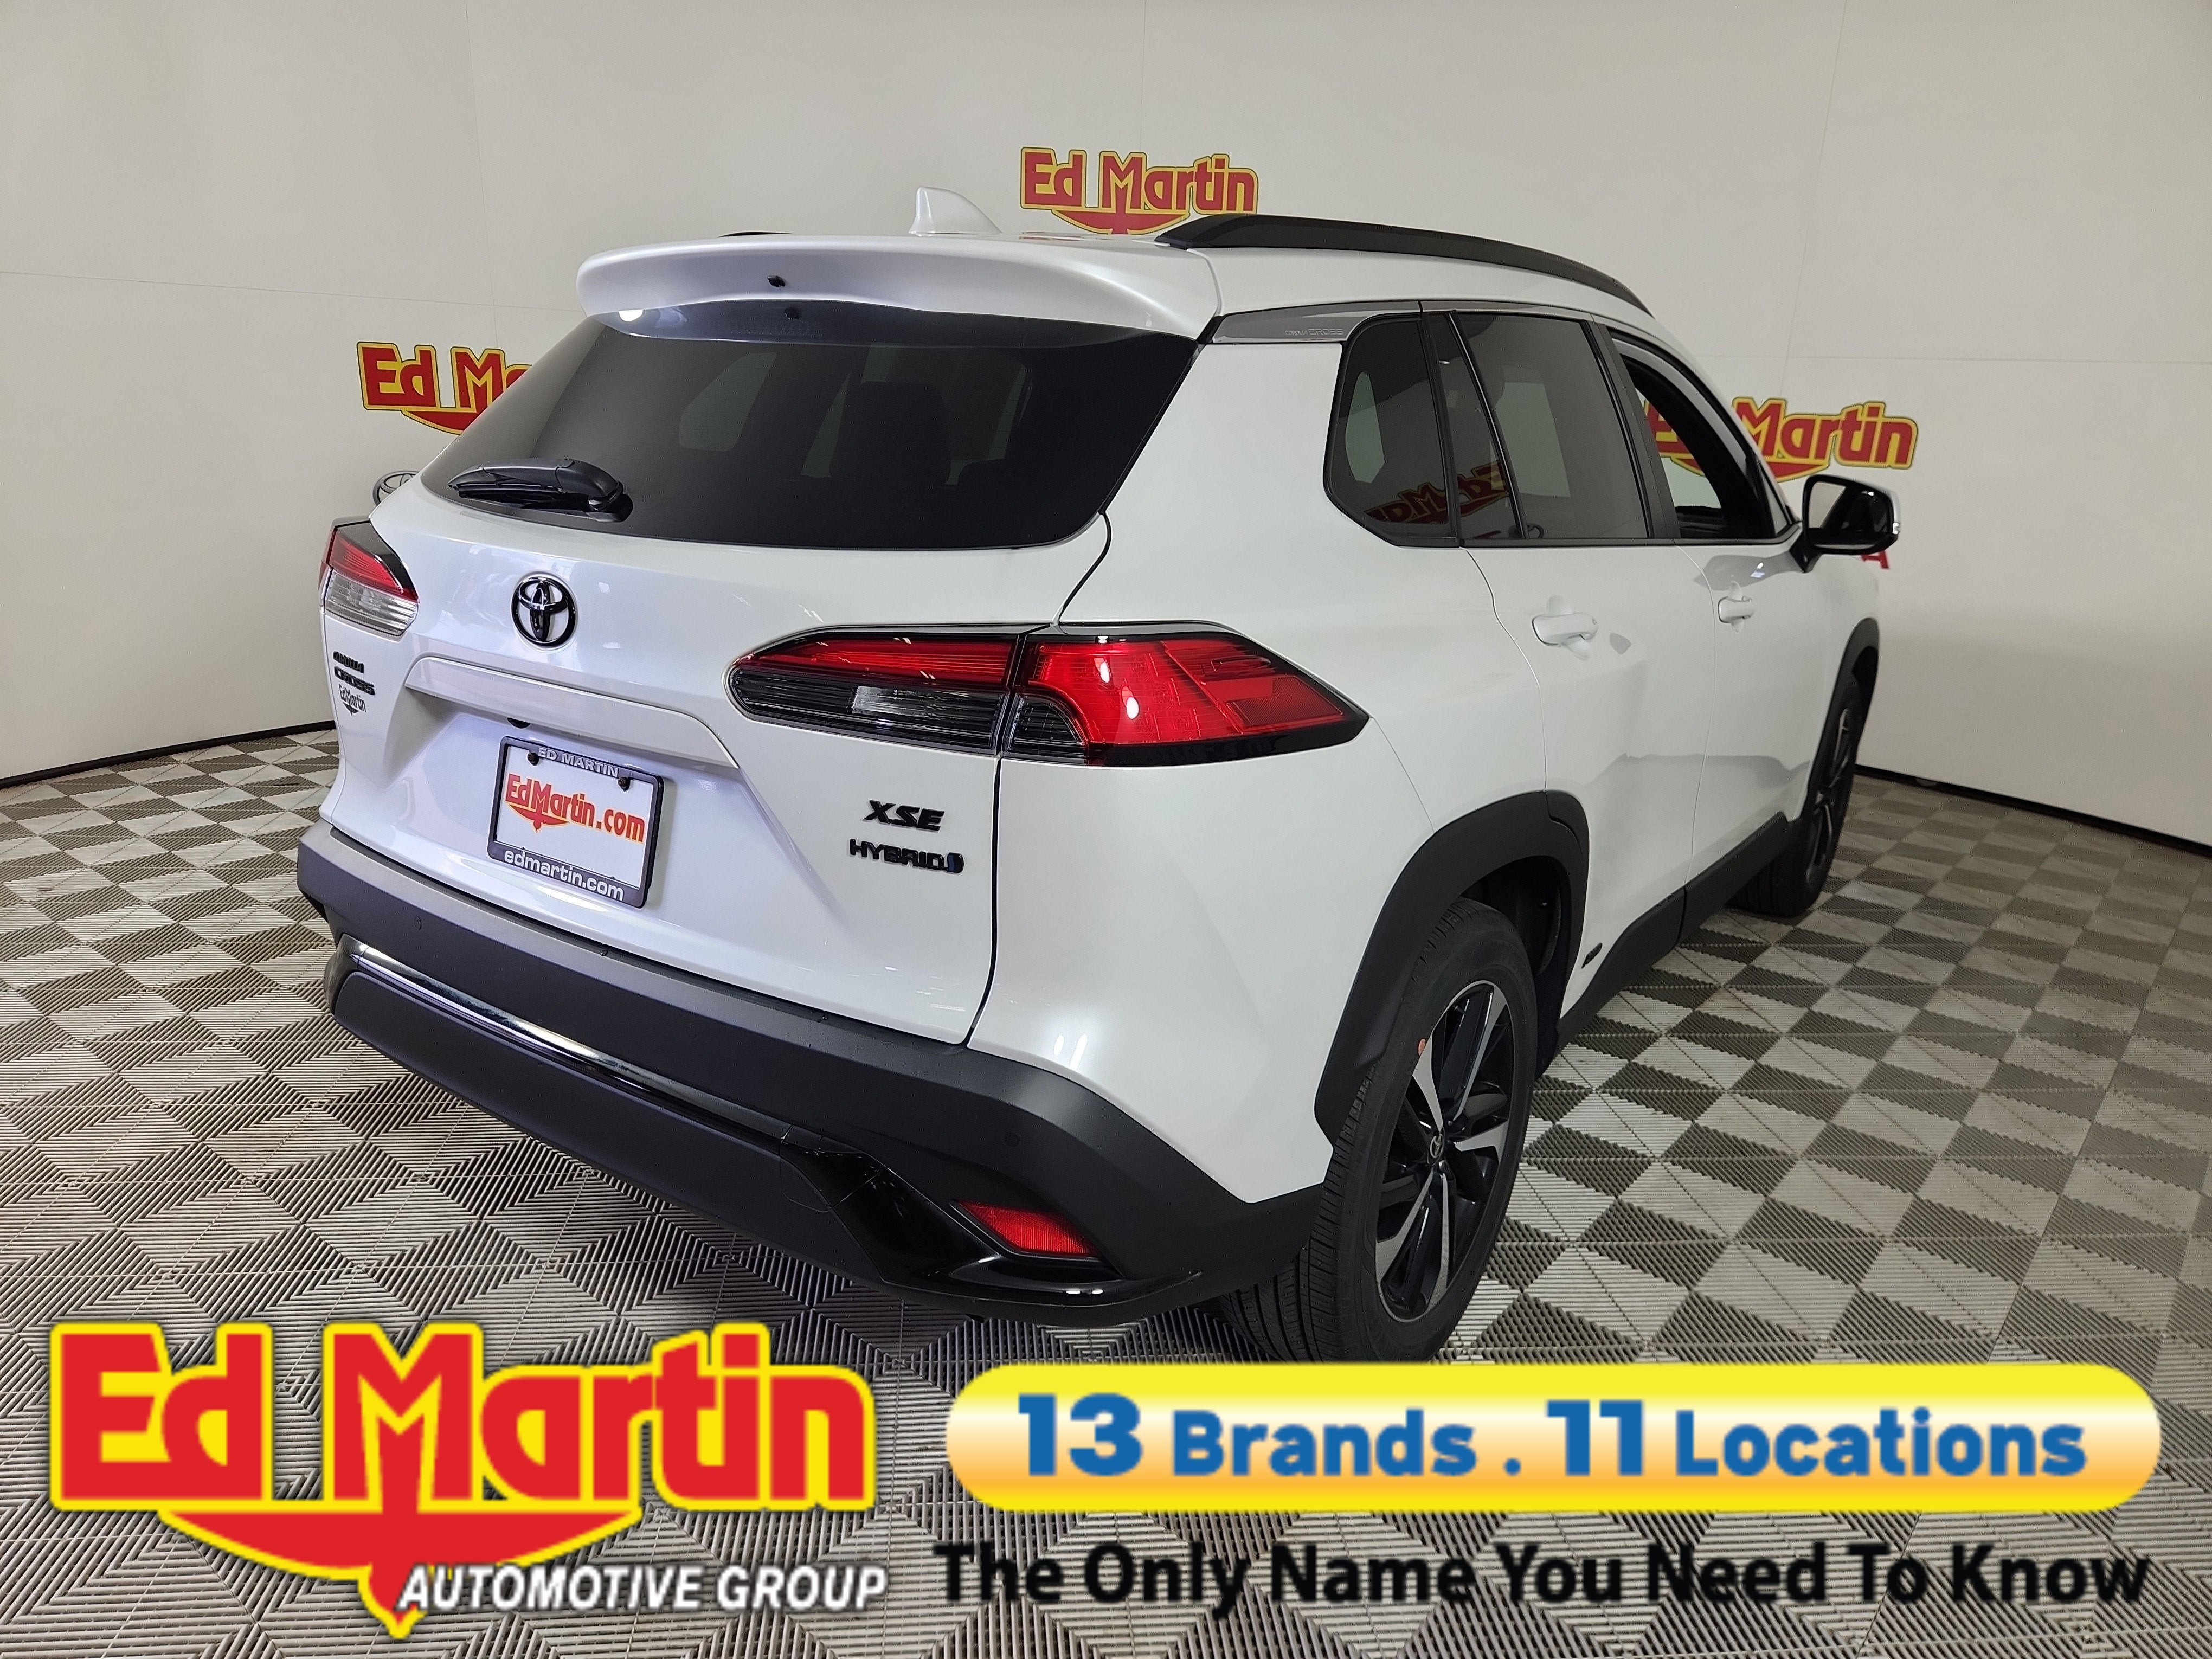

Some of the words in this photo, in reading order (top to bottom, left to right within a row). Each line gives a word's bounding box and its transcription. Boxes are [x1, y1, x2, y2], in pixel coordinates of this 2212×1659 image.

[1023, 148, 1085, 209] Ed
[1100, 152, 1257, 214] Martin
[358, 343, 439, 409] Ed
[334, 666, 375, 695] CROSS
[538, 748, 557, 760] ED
[561, 754, 619, 777] MARTIN
[862, 800, 945, 832] XSE
[849, 838, 946, 871] HYBRID
[504, 847, 624, 901] edmartin.com
